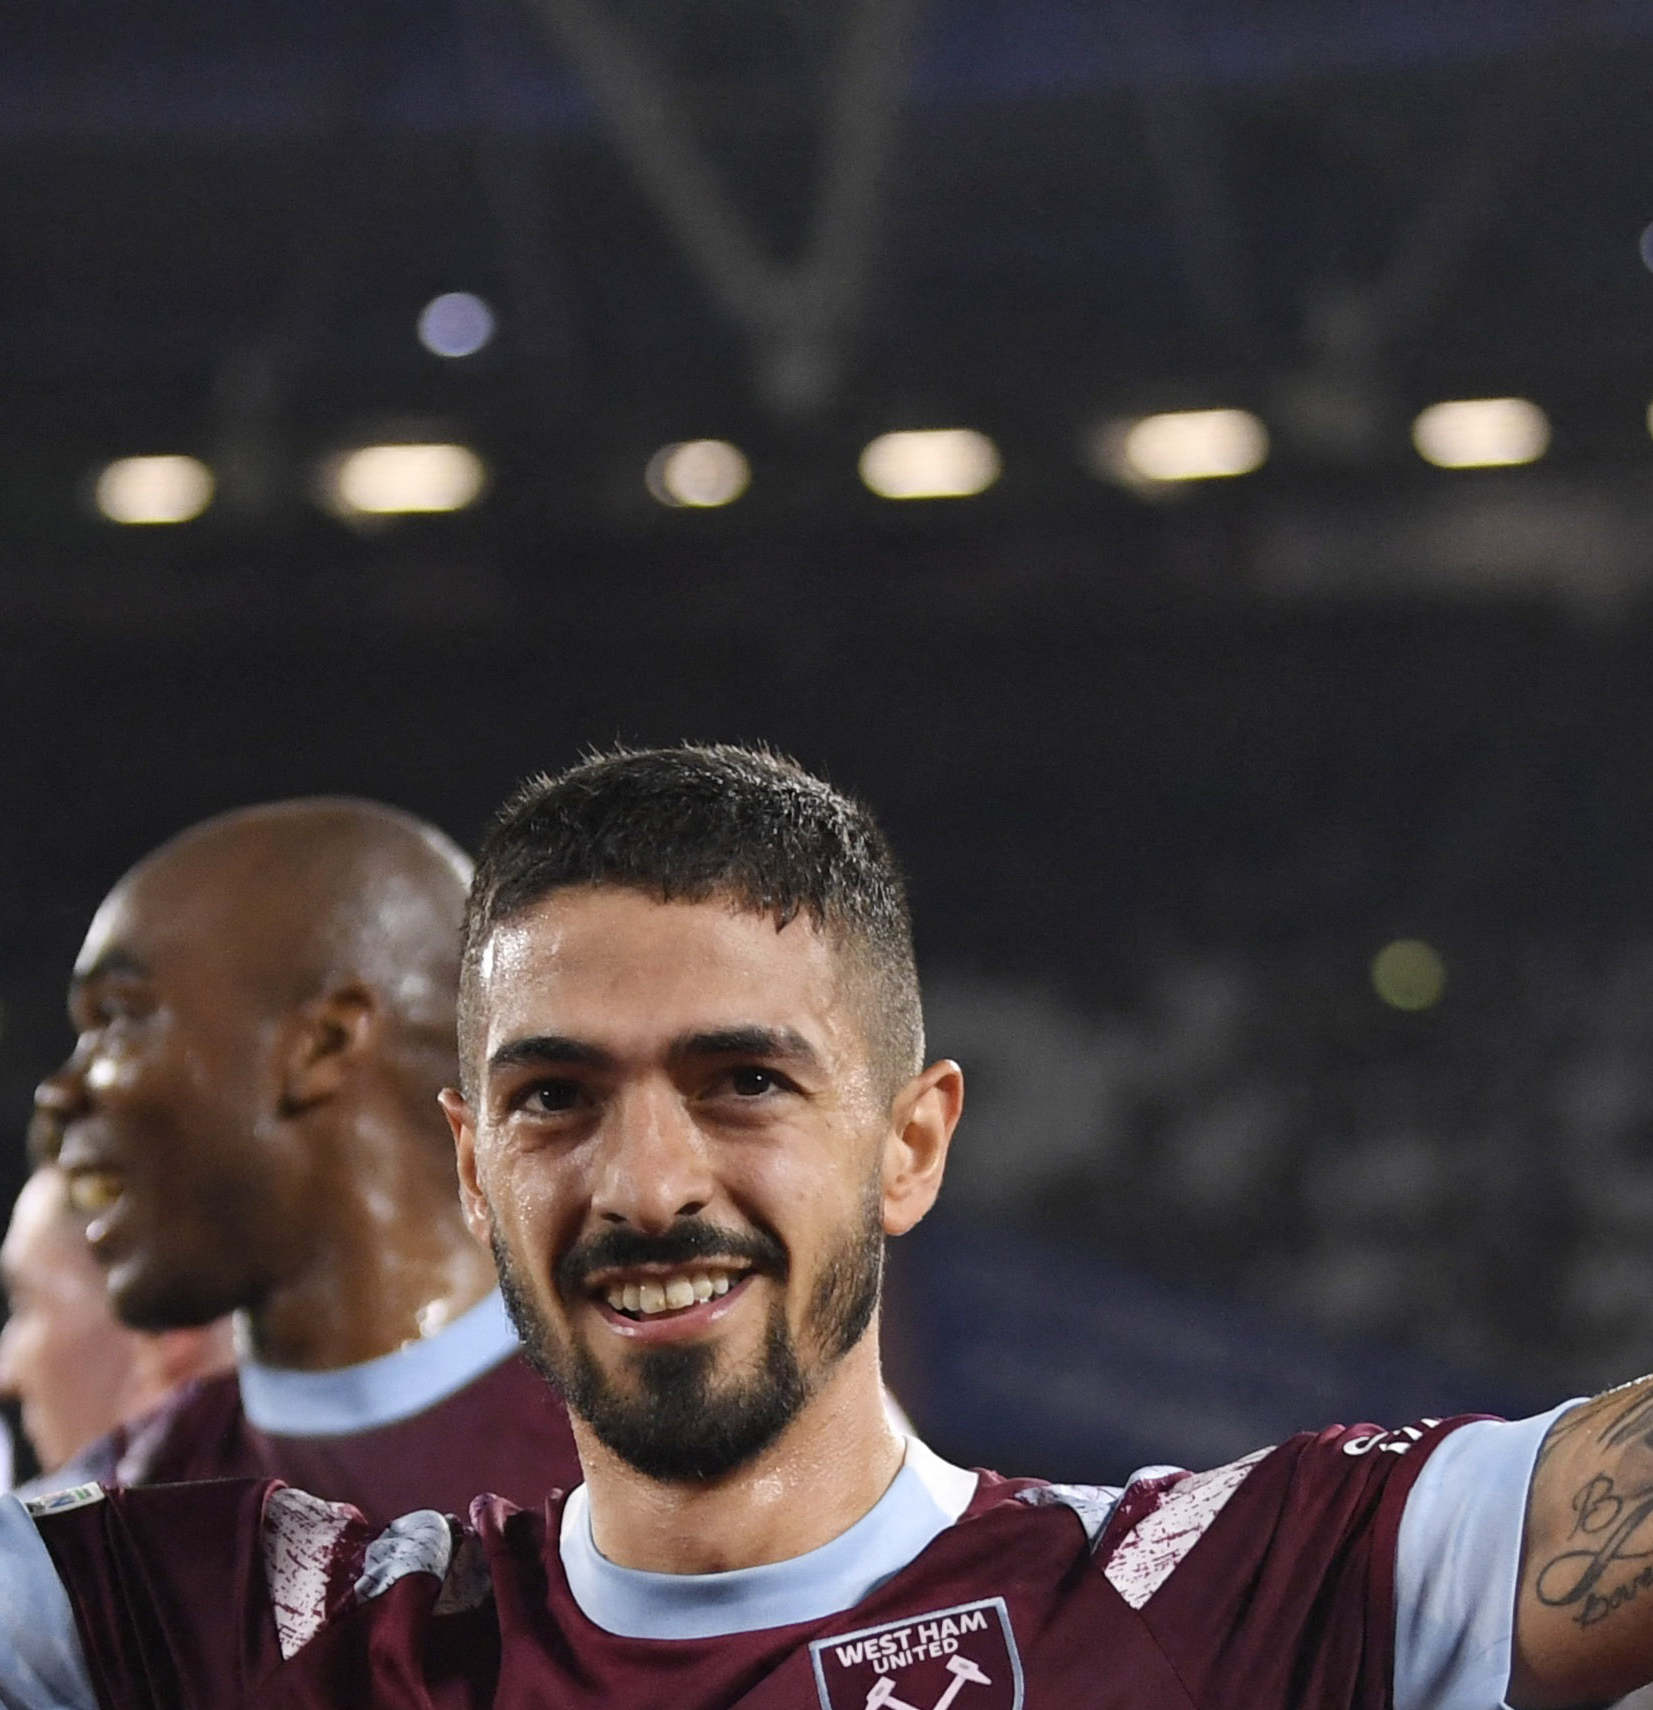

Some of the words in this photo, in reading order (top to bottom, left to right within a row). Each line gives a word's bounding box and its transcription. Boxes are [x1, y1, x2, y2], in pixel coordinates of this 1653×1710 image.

[835, 1629, 912, 1668] WEST
[917, 1610, 988, 1643] HAM
[872, 1637, 959, 1674] UNITED
